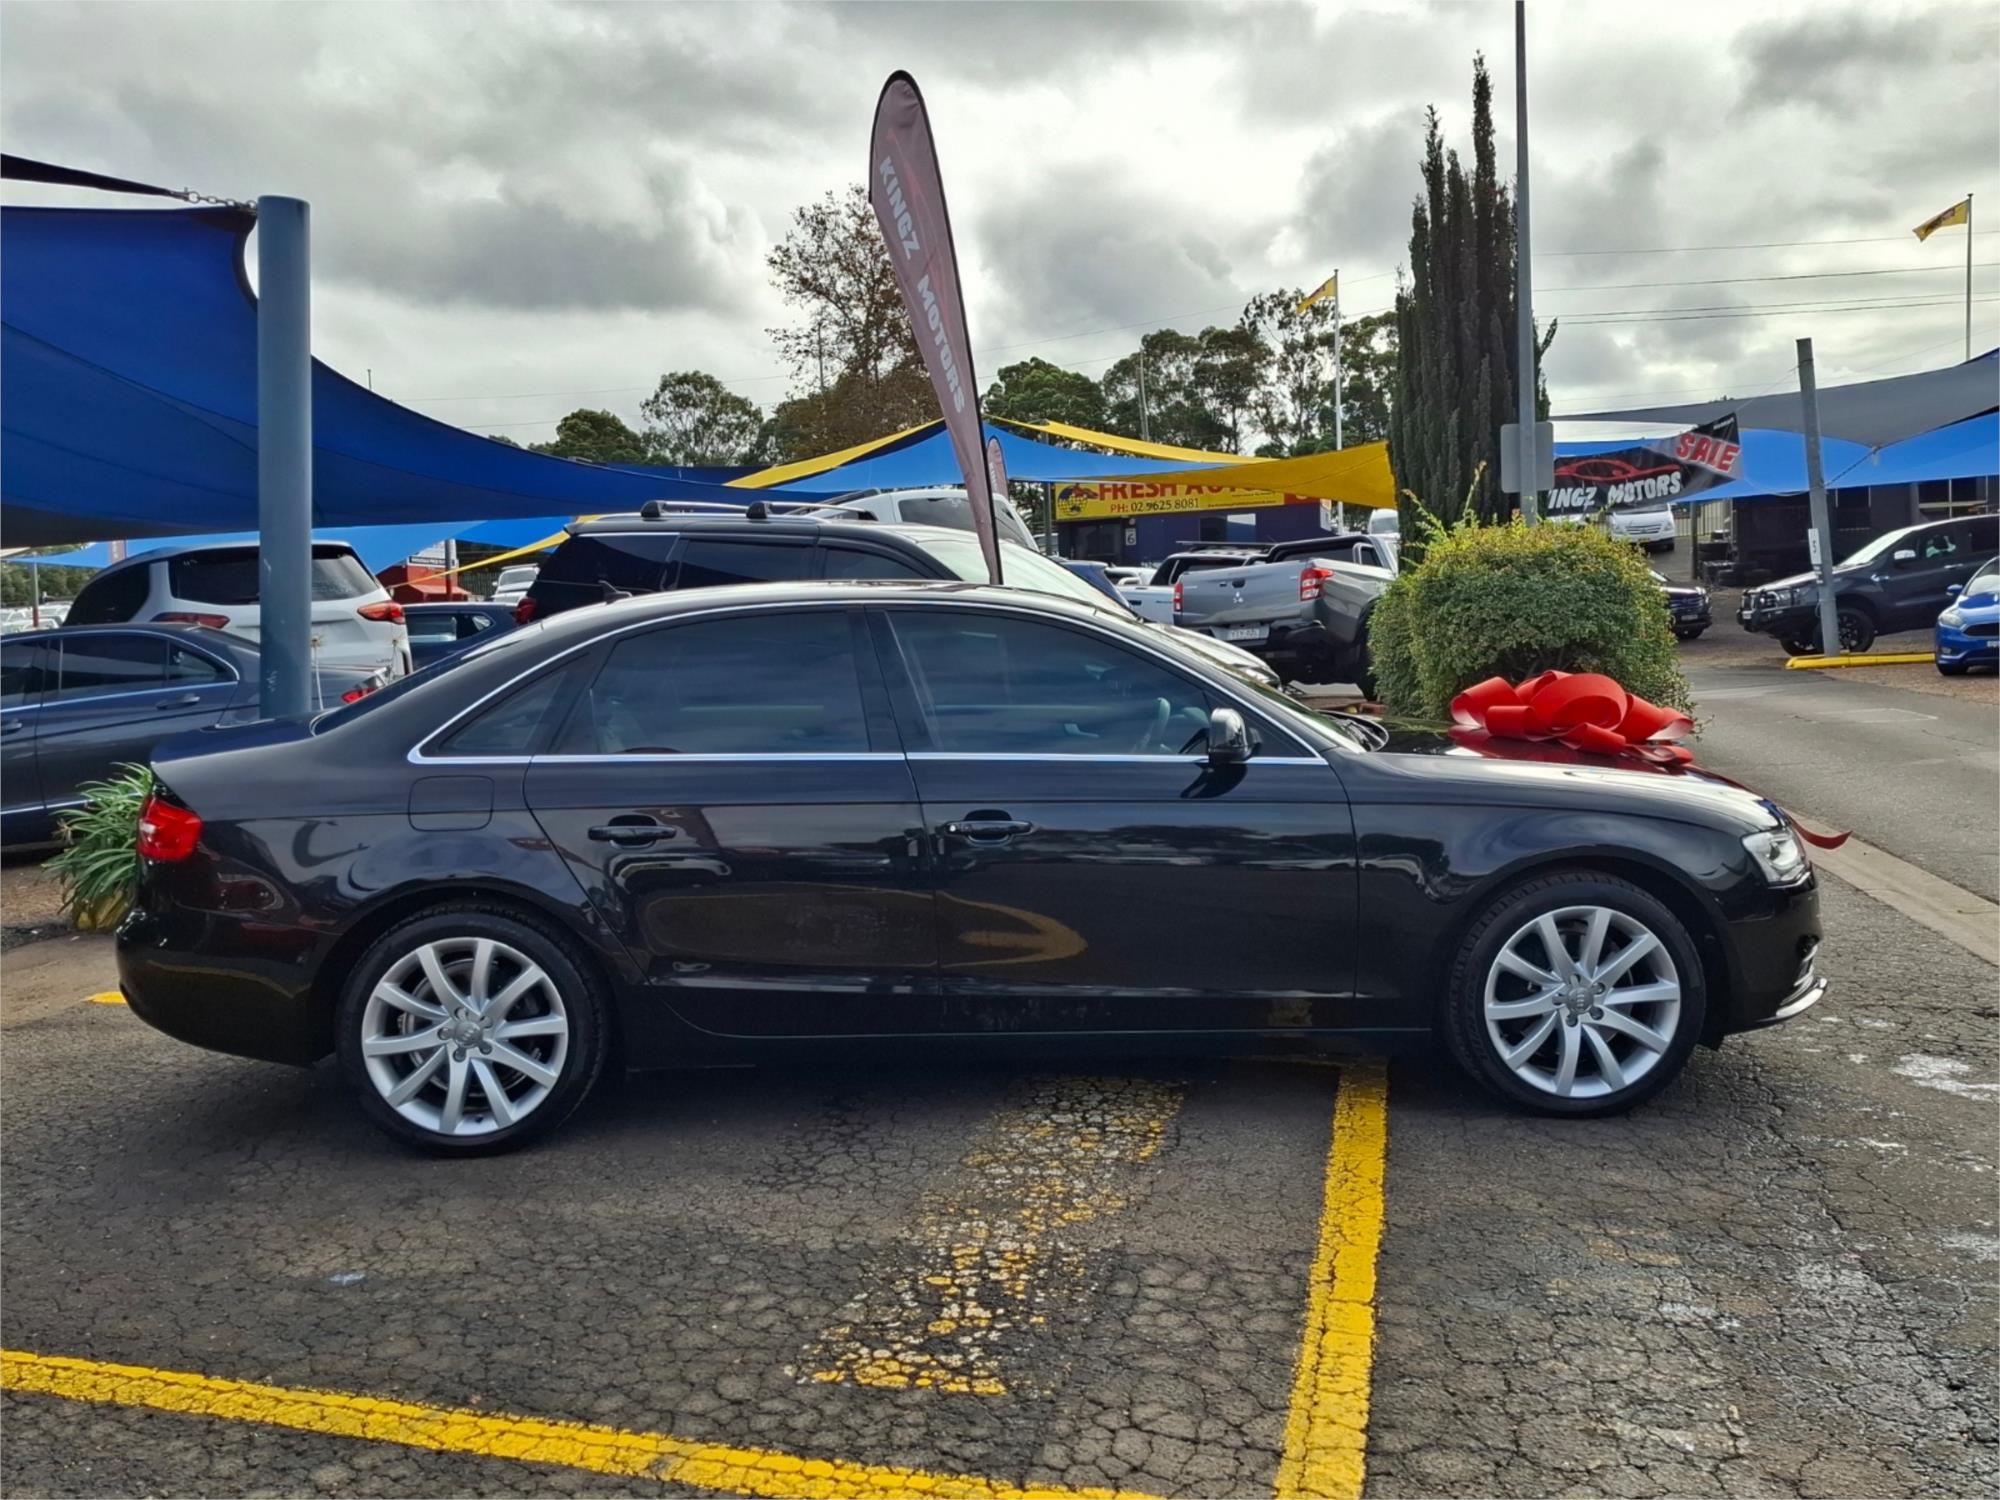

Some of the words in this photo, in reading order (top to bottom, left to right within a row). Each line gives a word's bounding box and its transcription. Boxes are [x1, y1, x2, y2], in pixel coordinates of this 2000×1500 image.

[880, 155, 920, 260] KINGZ
[917, 274, 965, 414] MOTORS
[1675, 432, 1741, 473] SALE
[1098, 483, 1178, 501] FRESH
[1548, 485, 1597, 510] INGZ
[1607, 471, 1681, 504] MOTORS
[1110, 504, 1129, 513] PH:
[1131, 502, 1144, 513] 02
[1146, 500, 1171, 511] 9625
[1174, 498, 1199, 510] 8081
[1127, 533, 1135, 544] 6
